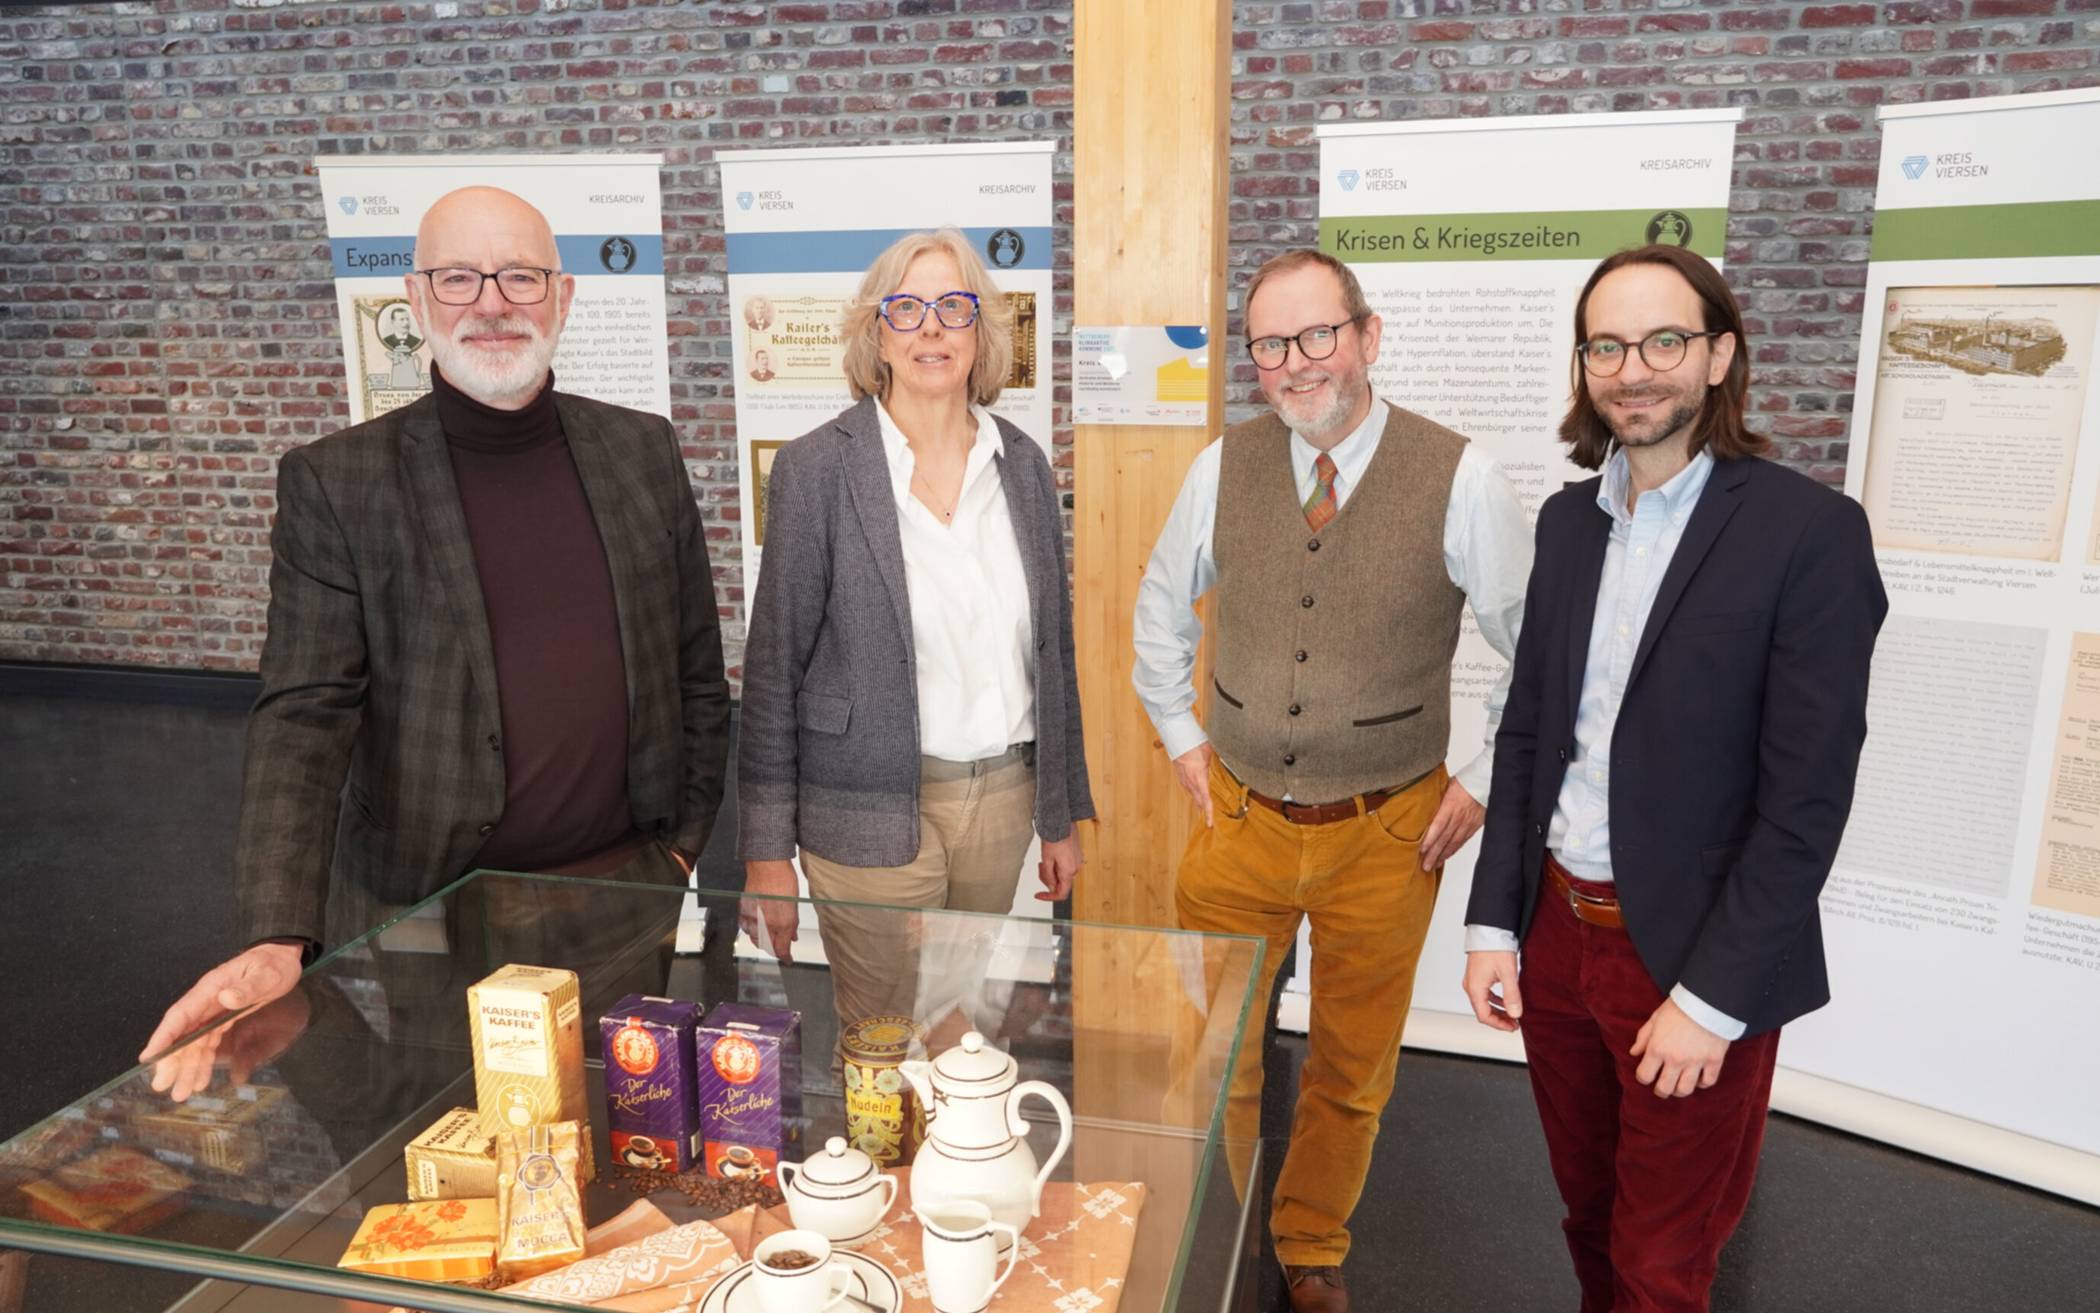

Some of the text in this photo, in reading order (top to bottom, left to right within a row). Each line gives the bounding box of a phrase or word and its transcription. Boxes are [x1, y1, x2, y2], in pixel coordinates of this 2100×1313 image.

[1640, 158, 1712, 170] KREISARCHIV
[1936, 152, 1973, 165] KREIS
[1365, 168, 1394, 179] KREIS
[1936, 165, 1990, 178] VIERSEN
[979, 185, 1036, 194] KREISARCHIV
[1365, 180, 1407, 191] VIERSEN
[362, 196, 387, 205] KREIS
[589, 194, 645, 204] KREISARCHIV
[758, 190, 782, 201] KREIS
[364, 206, 400, 216] VIERSEN
[760, 200, 794, 211] VIERSEN
[1337, 225, 1580, 255] Krisen & Kriegszeiten
[346, 247, 415, 272] Expans
[1382, 289, 1421, 300] Weltkrieg
[1426, 288, 1470, 298] bedrohten
[1476, 287, 1556, 299] Rohstoffknappheit
[1428, 304, 1443, 313] das
[1520, 303, 1555, 313] Kaiser's
[1406, 319, 1420, 328] auf
[1424, 318, 1513, 329] Munitionsproduktion
[1539, 318, 1554, 328] Die
[1399, 333, 1439, 342] Krisenzeit
[1445, 333, 1459, 342] der
[1466, 333, 1507, 343] Weimarer
[1391, 349, 1403, 358] die
[1471, 349, 1515, 358] überstand
[1519, 349, 1552, 358] Kaiser's
[641, 361, 653, 369] auf
[1369, 363, 1550, 374] schaft auch durch konsequente Marken-
[1412, 378, 1439, 387] seines
[1395, 393, 1548, 404] und seiner Unterstützung Bedürftiger
[1435, 408, 1452, 416] und
[1458, 408, 1548, 418] Weltwirtschaftskrise
[1462, 423, 1516, 434] Ehrenbürger
[1520, 424, 1547, 432] seiner
[1526, 476, 1544, 486] und
[1937, 574, 2004, 589] Stadtverwaltung
[2023, 935, 2081, 953] Unternehmen
[482, 1005, 541, 1020] KAISER'S
[489, 1016, 536, 1030] KAFFEE
[621, 1078, 648, 1093] Der
[610, 1083, 673, 1116] Kaiserliche
[720, 1087, 747, 1103] Der
[704, 1093, 774, 1126] Kaiserliche
[850, 1096, 893, 1114] Nudeln
[518, 1232, 569, 1249] MOCCA
